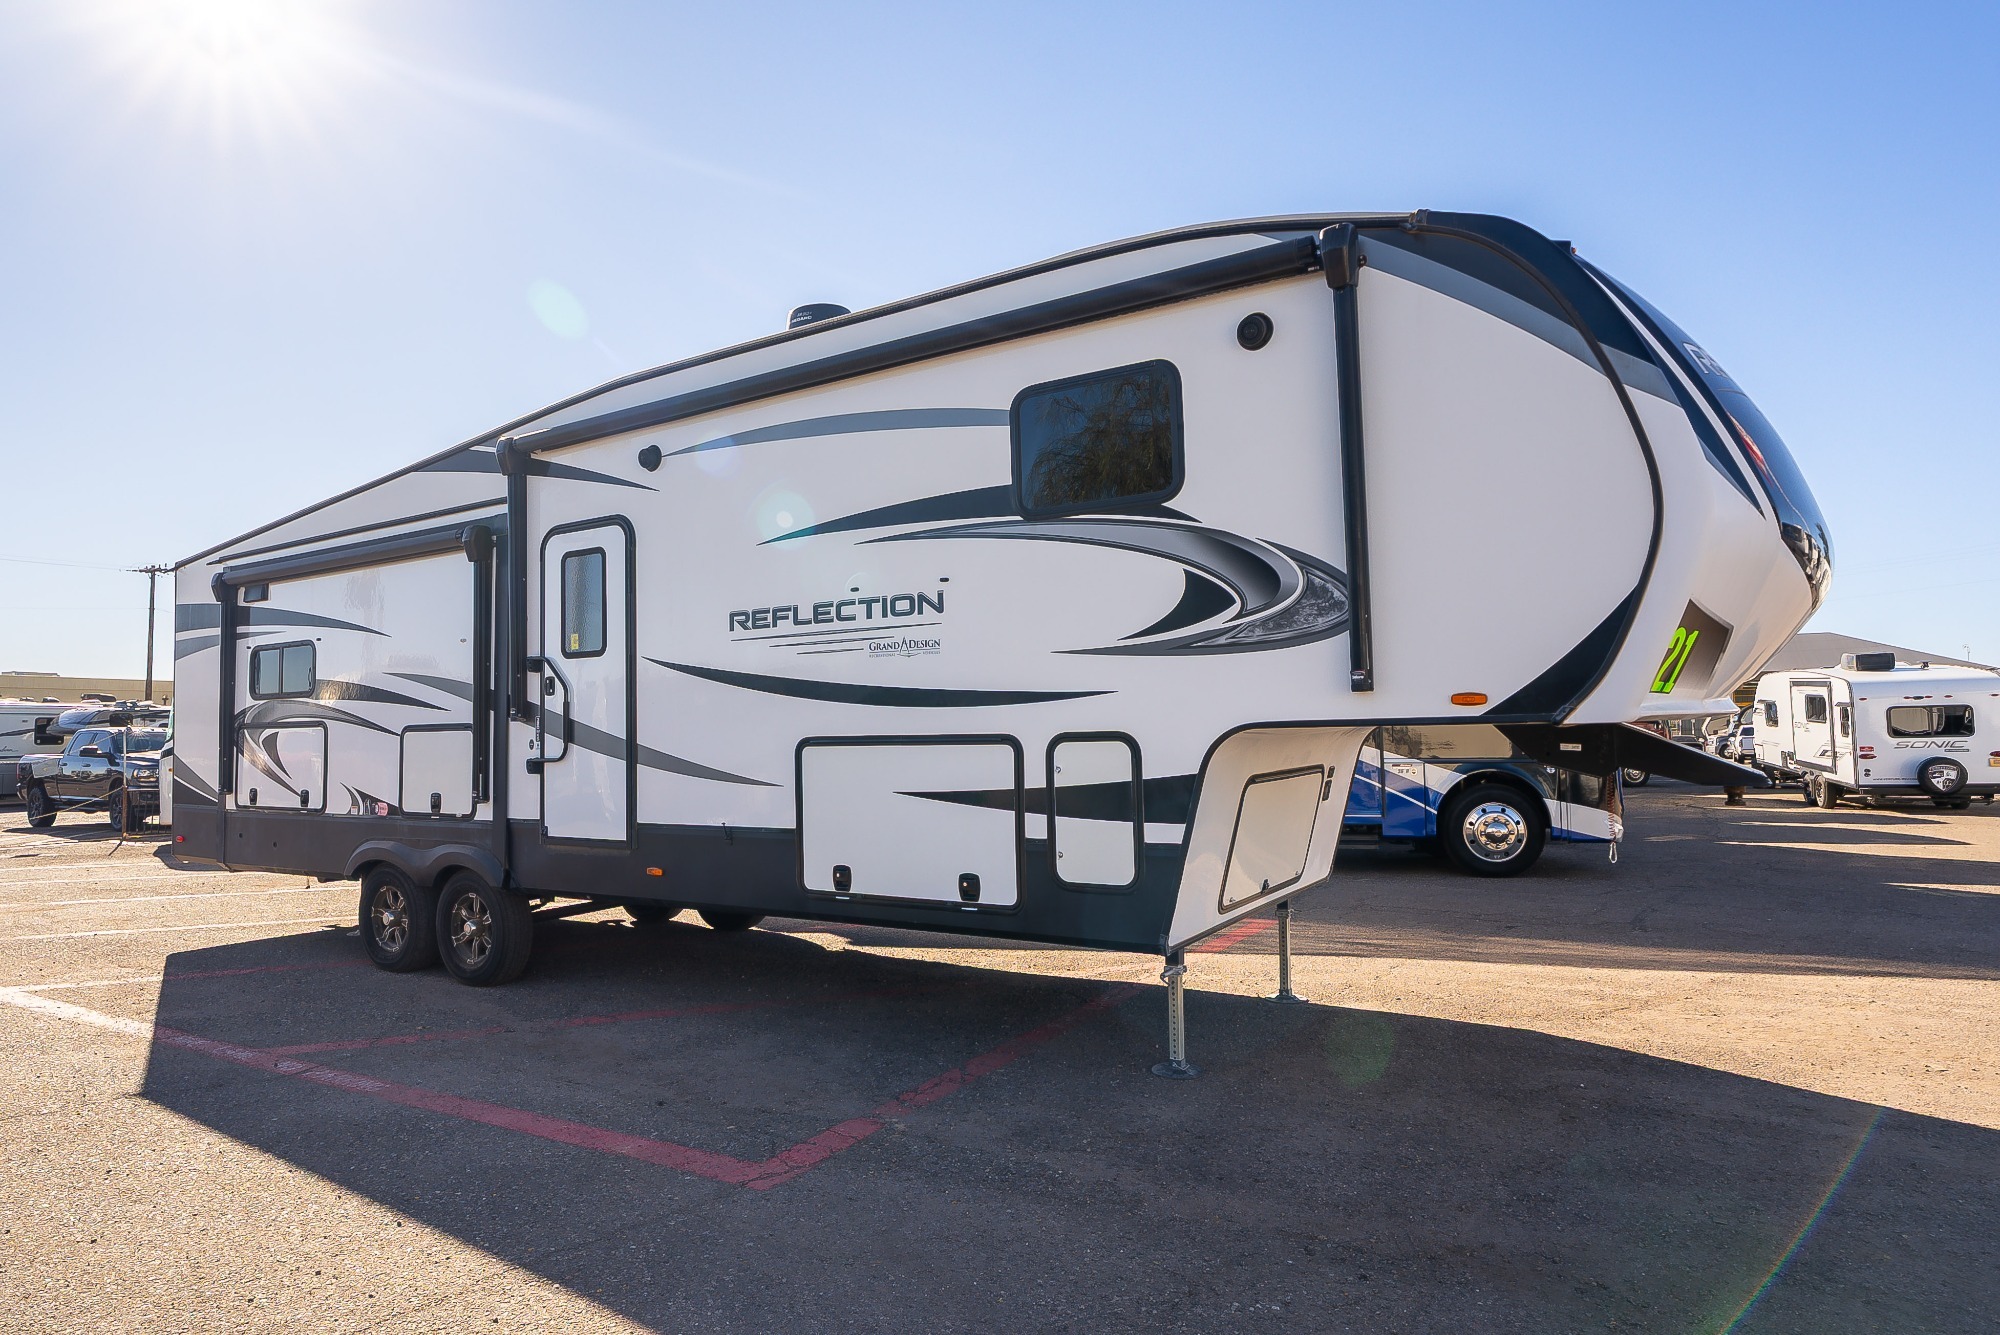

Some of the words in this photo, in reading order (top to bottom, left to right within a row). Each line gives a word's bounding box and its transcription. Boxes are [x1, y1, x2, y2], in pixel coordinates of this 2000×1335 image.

[729, 590, 945, 632] REFLECTION
[869, 641, 901, 651] GRAND
[908, 638, 941, 649] DESIGN
[1650, 626, 1699, 693] 21
[1894, 740, 1969, 749] SONIC
